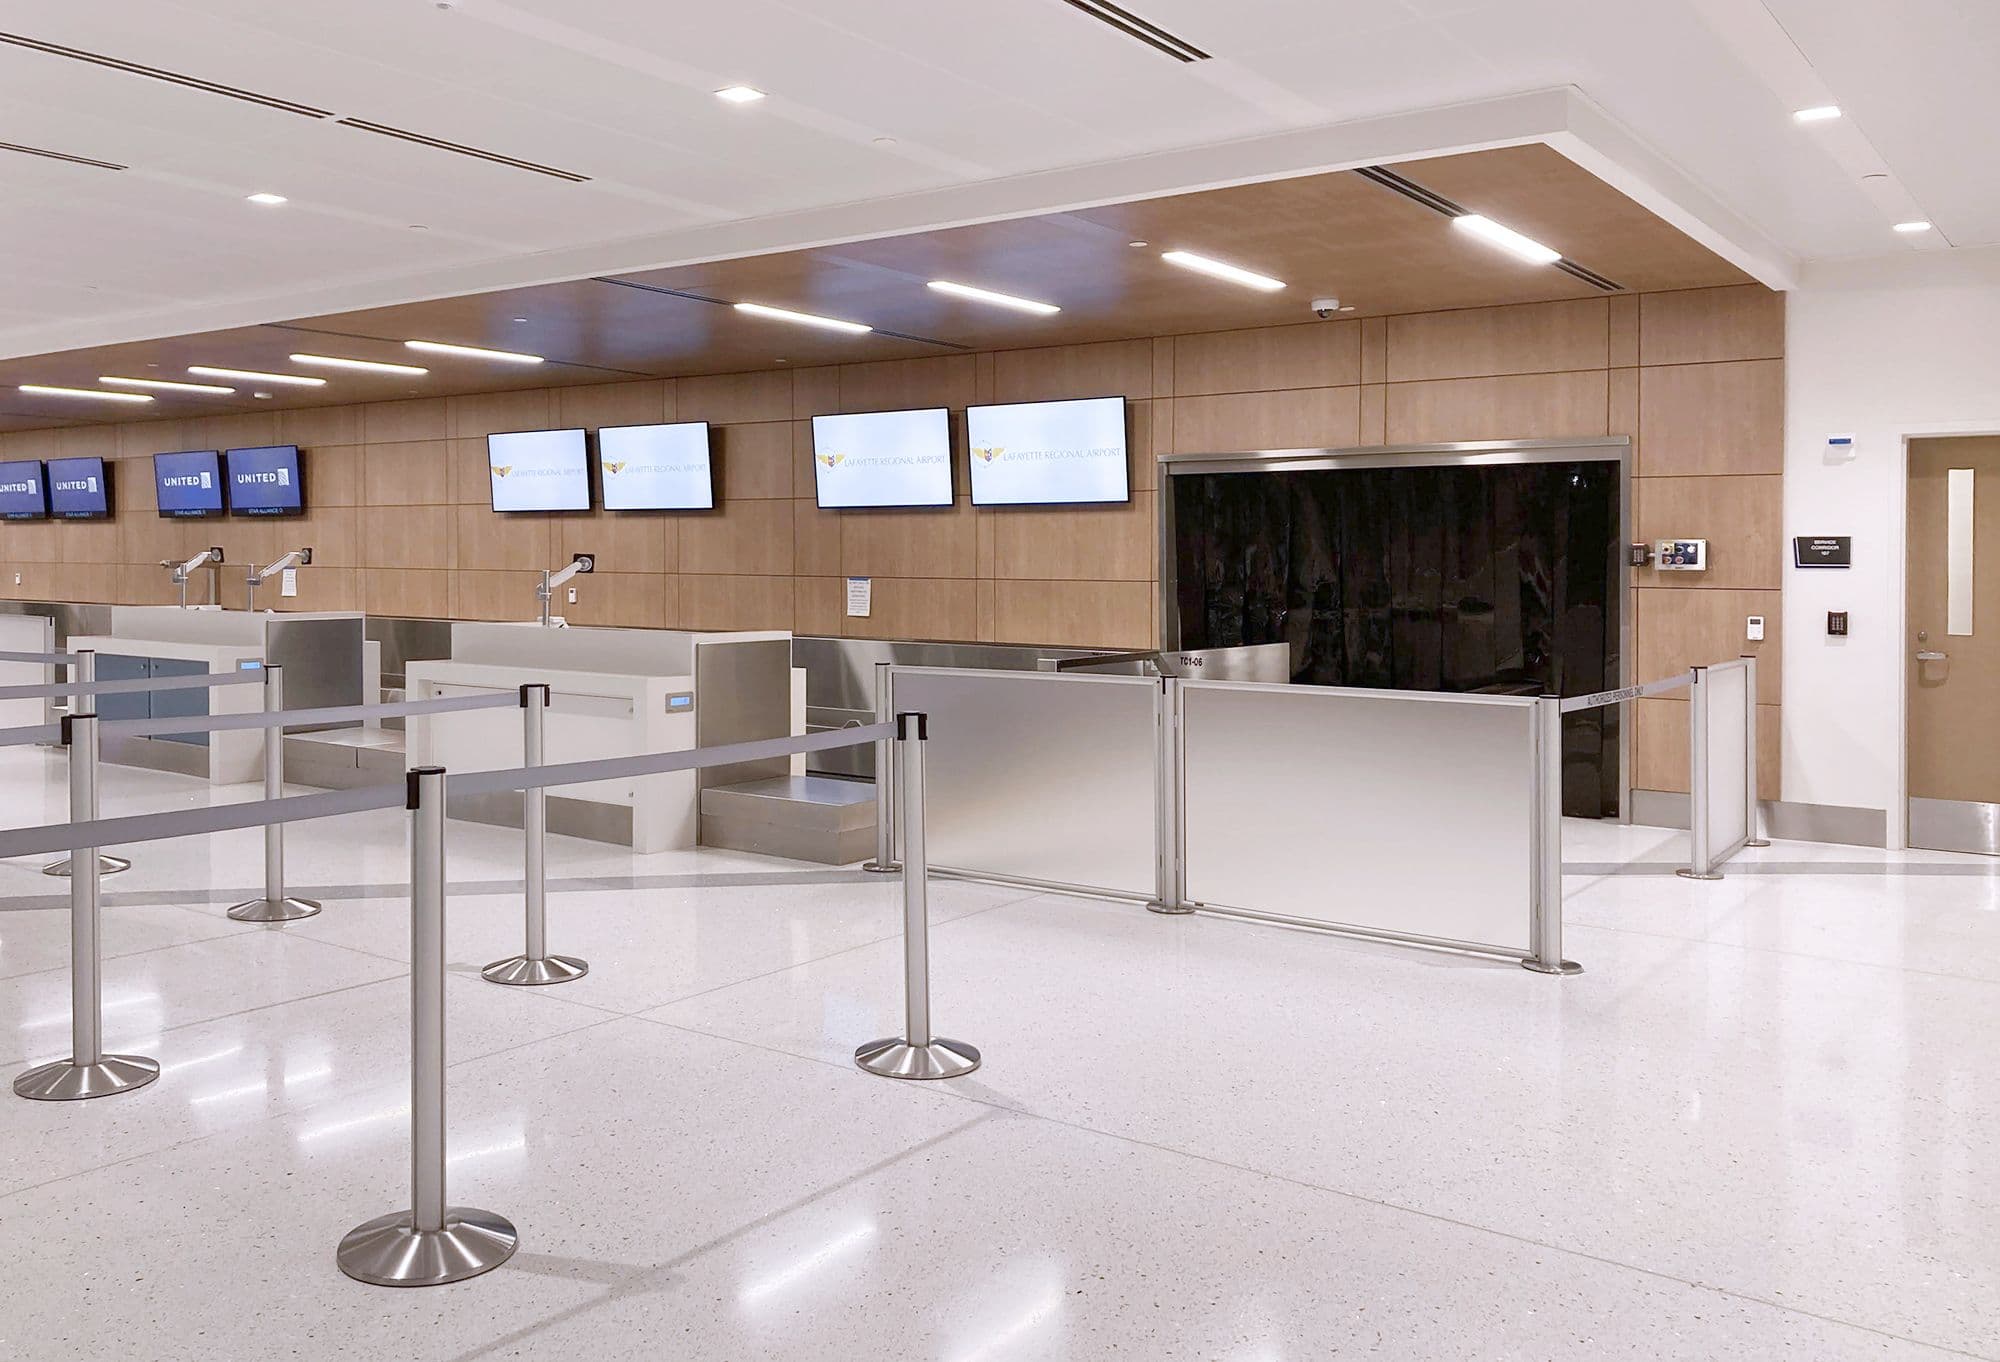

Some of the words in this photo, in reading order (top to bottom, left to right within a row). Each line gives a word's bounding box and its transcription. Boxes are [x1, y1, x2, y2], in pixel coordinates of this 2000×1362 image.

[1003, 452, 1042, 461] LAFAYETTE
[1045, 450, 1085, 459] REGIONAL
[1087, 448, 1121, 457] AIRPORT
[917, 456, 945, 464] AIRPORT
[164, 476, 200, 487] UNITED
[237, 473, 277, 484] UNITED
[56, 481, 87, 490] UNITED
[1180, 657, 1203, 666] TC1-06
